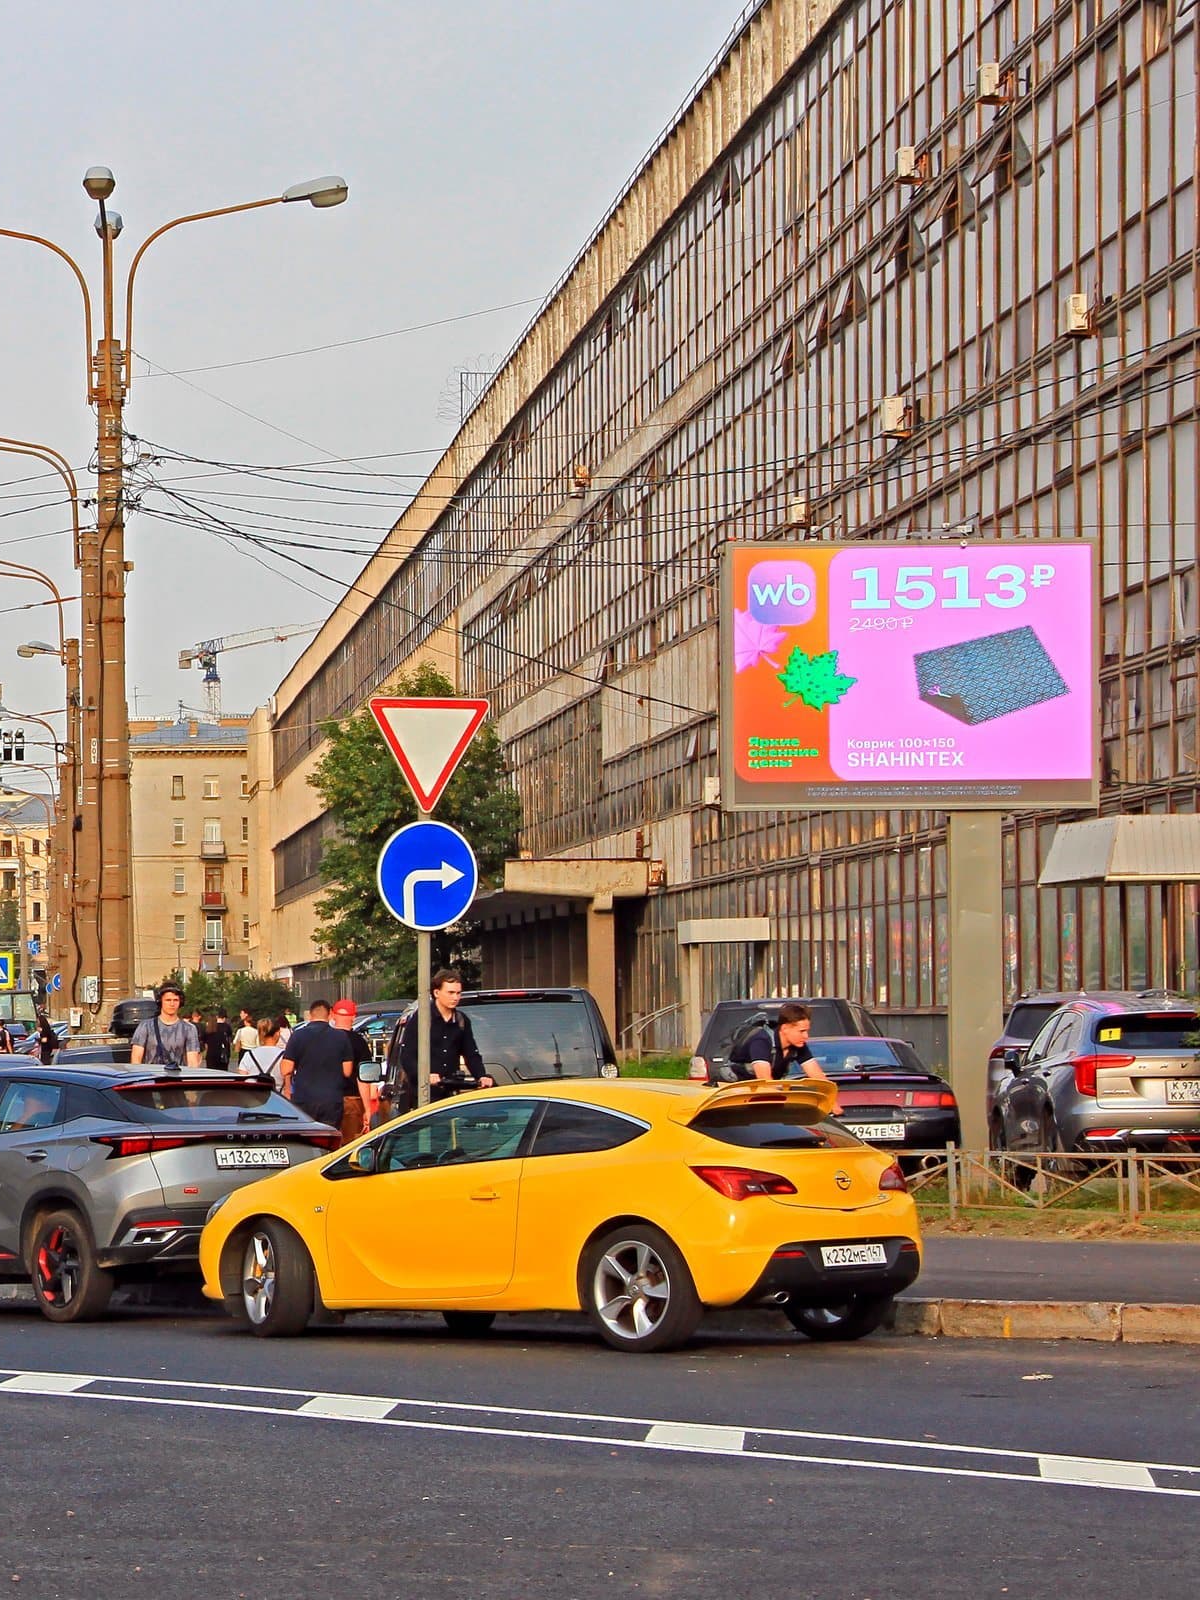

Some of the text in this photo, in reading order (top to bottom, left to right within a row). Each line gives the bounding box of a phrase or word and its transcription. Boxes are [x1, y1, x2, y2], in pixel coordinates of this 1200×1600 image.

[752, 574, 811, 606] wb
[748, 736, 800, 748] Яркие
[847, 738, 895, 751] Коврик
[748, 748, 819, 758] осенние
[847, 751, 964, 767] SHAHINTEX
[748, 759, 793, 769] цены
